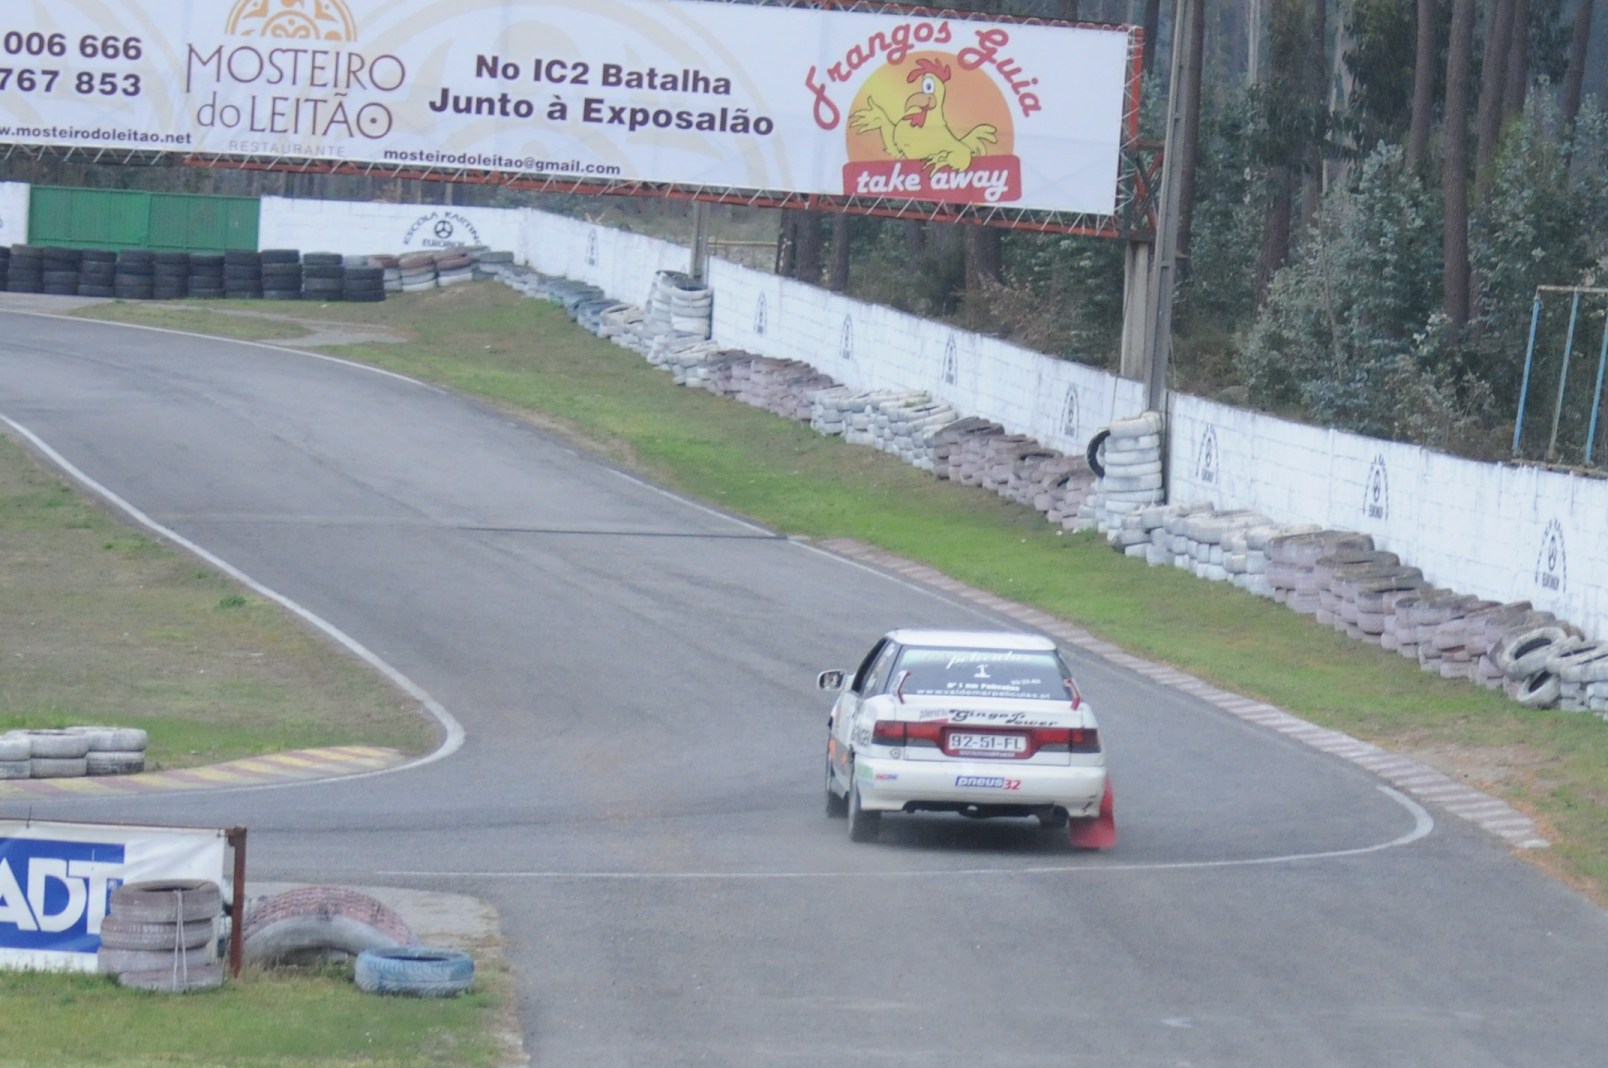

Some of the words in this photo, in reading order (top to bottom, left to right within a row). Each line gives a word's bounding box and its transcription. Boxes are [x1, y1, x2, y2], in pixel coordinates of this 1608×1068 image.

[4, 31, 66, 57] 006
[79, 35, 142, 60] 666
[0, 68, 60, 92] 767
[75, 71, 141, 96] 853
[186, 43, 405, 93] MOSTEIRO
[475, 54, 520, 80] No
[534, 58, 589, 85] IC2
[601, 63, 731, 95] Batalha
[805, 21, 952, 130] Frangos
[957, 28, 1042, 117] Guia
[197, 91, 241, 128] do
[249, 92, 393, 140] LEITÃO
[429, 87, 533, 118] Junto
[546, 94, 568, 121] à
[582, 97, 774, 136] Exposalão
[229, 140, 345, 157] RESTAURANTE
[384, 149, 620, 175] mosteirodoleitao@gmail.com
[857, 163, 922, 193] take
[930, 169, 1009, 200] away
